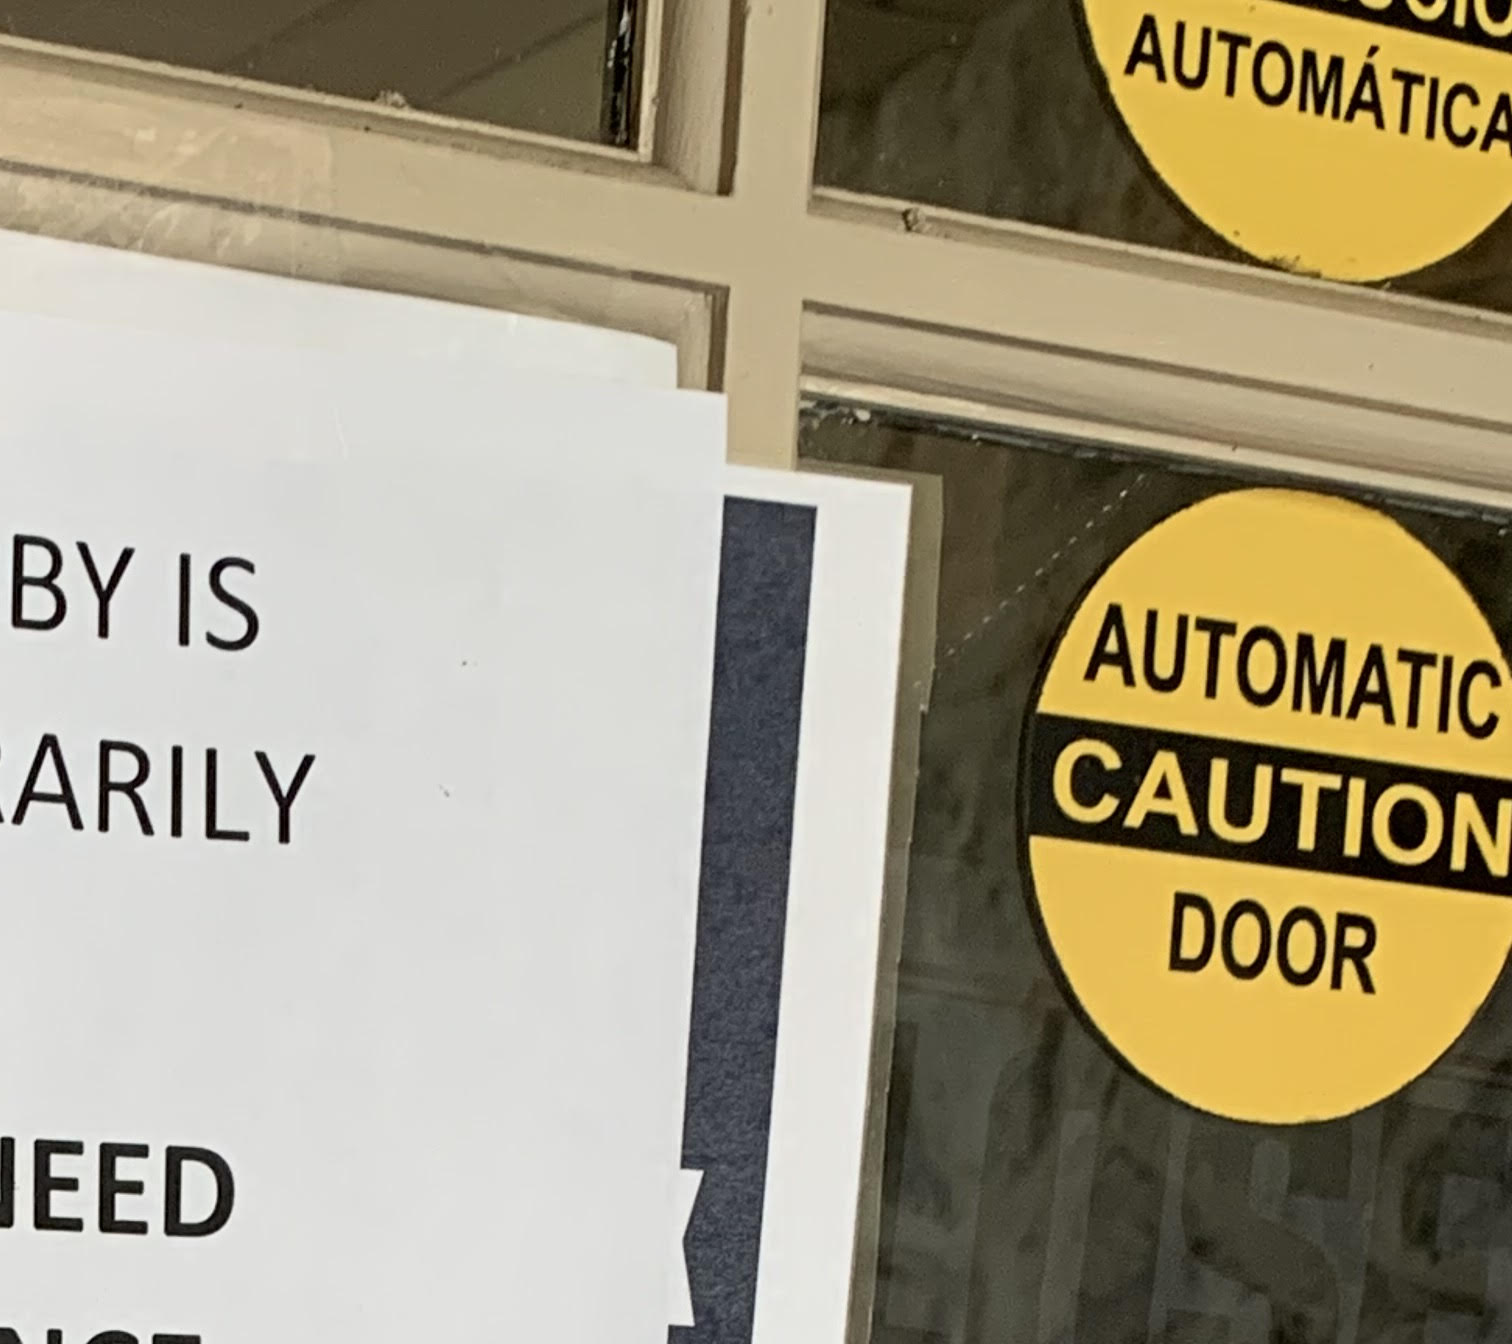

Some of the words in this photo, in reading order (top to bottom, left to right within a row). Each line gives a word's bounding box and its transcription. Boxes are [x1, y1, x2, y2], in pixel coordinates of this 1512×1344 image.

[1121, 11, 1512, 160] AUTOMÁTICA
[175, 550, 262, 654] IS
[1081, 600, 1504, 743] AUTOMATIC
[1050, 736, 1512, 880] CAUTION
[1166, 889, 1379, 997] DOOR
